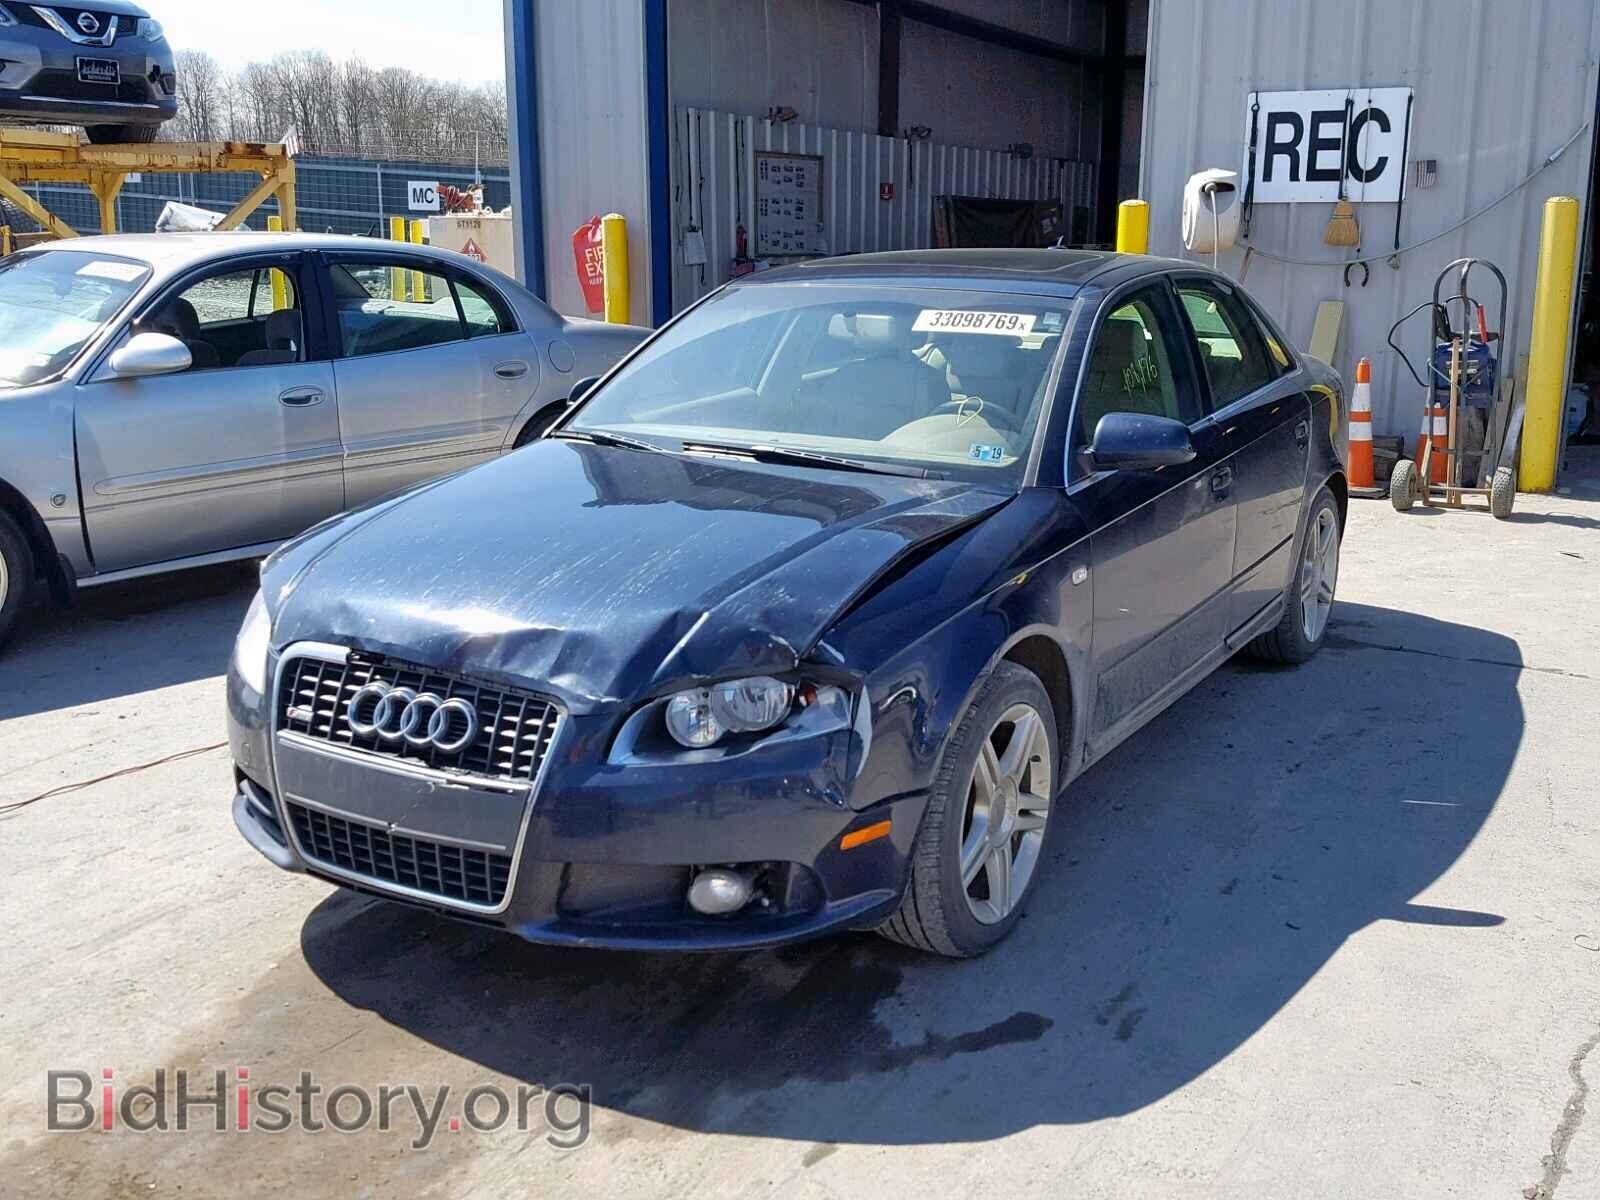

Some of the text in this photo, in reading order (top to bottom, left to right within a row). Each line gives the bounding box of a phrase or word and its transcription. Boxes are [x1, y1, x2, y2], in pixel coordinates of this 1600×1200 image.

[1262, 107, 1391, 183] REC
[412, 187, 435, 204] MC
[585, 246, 604, 263] FIR
[991, 447, 1002, 460] 19
